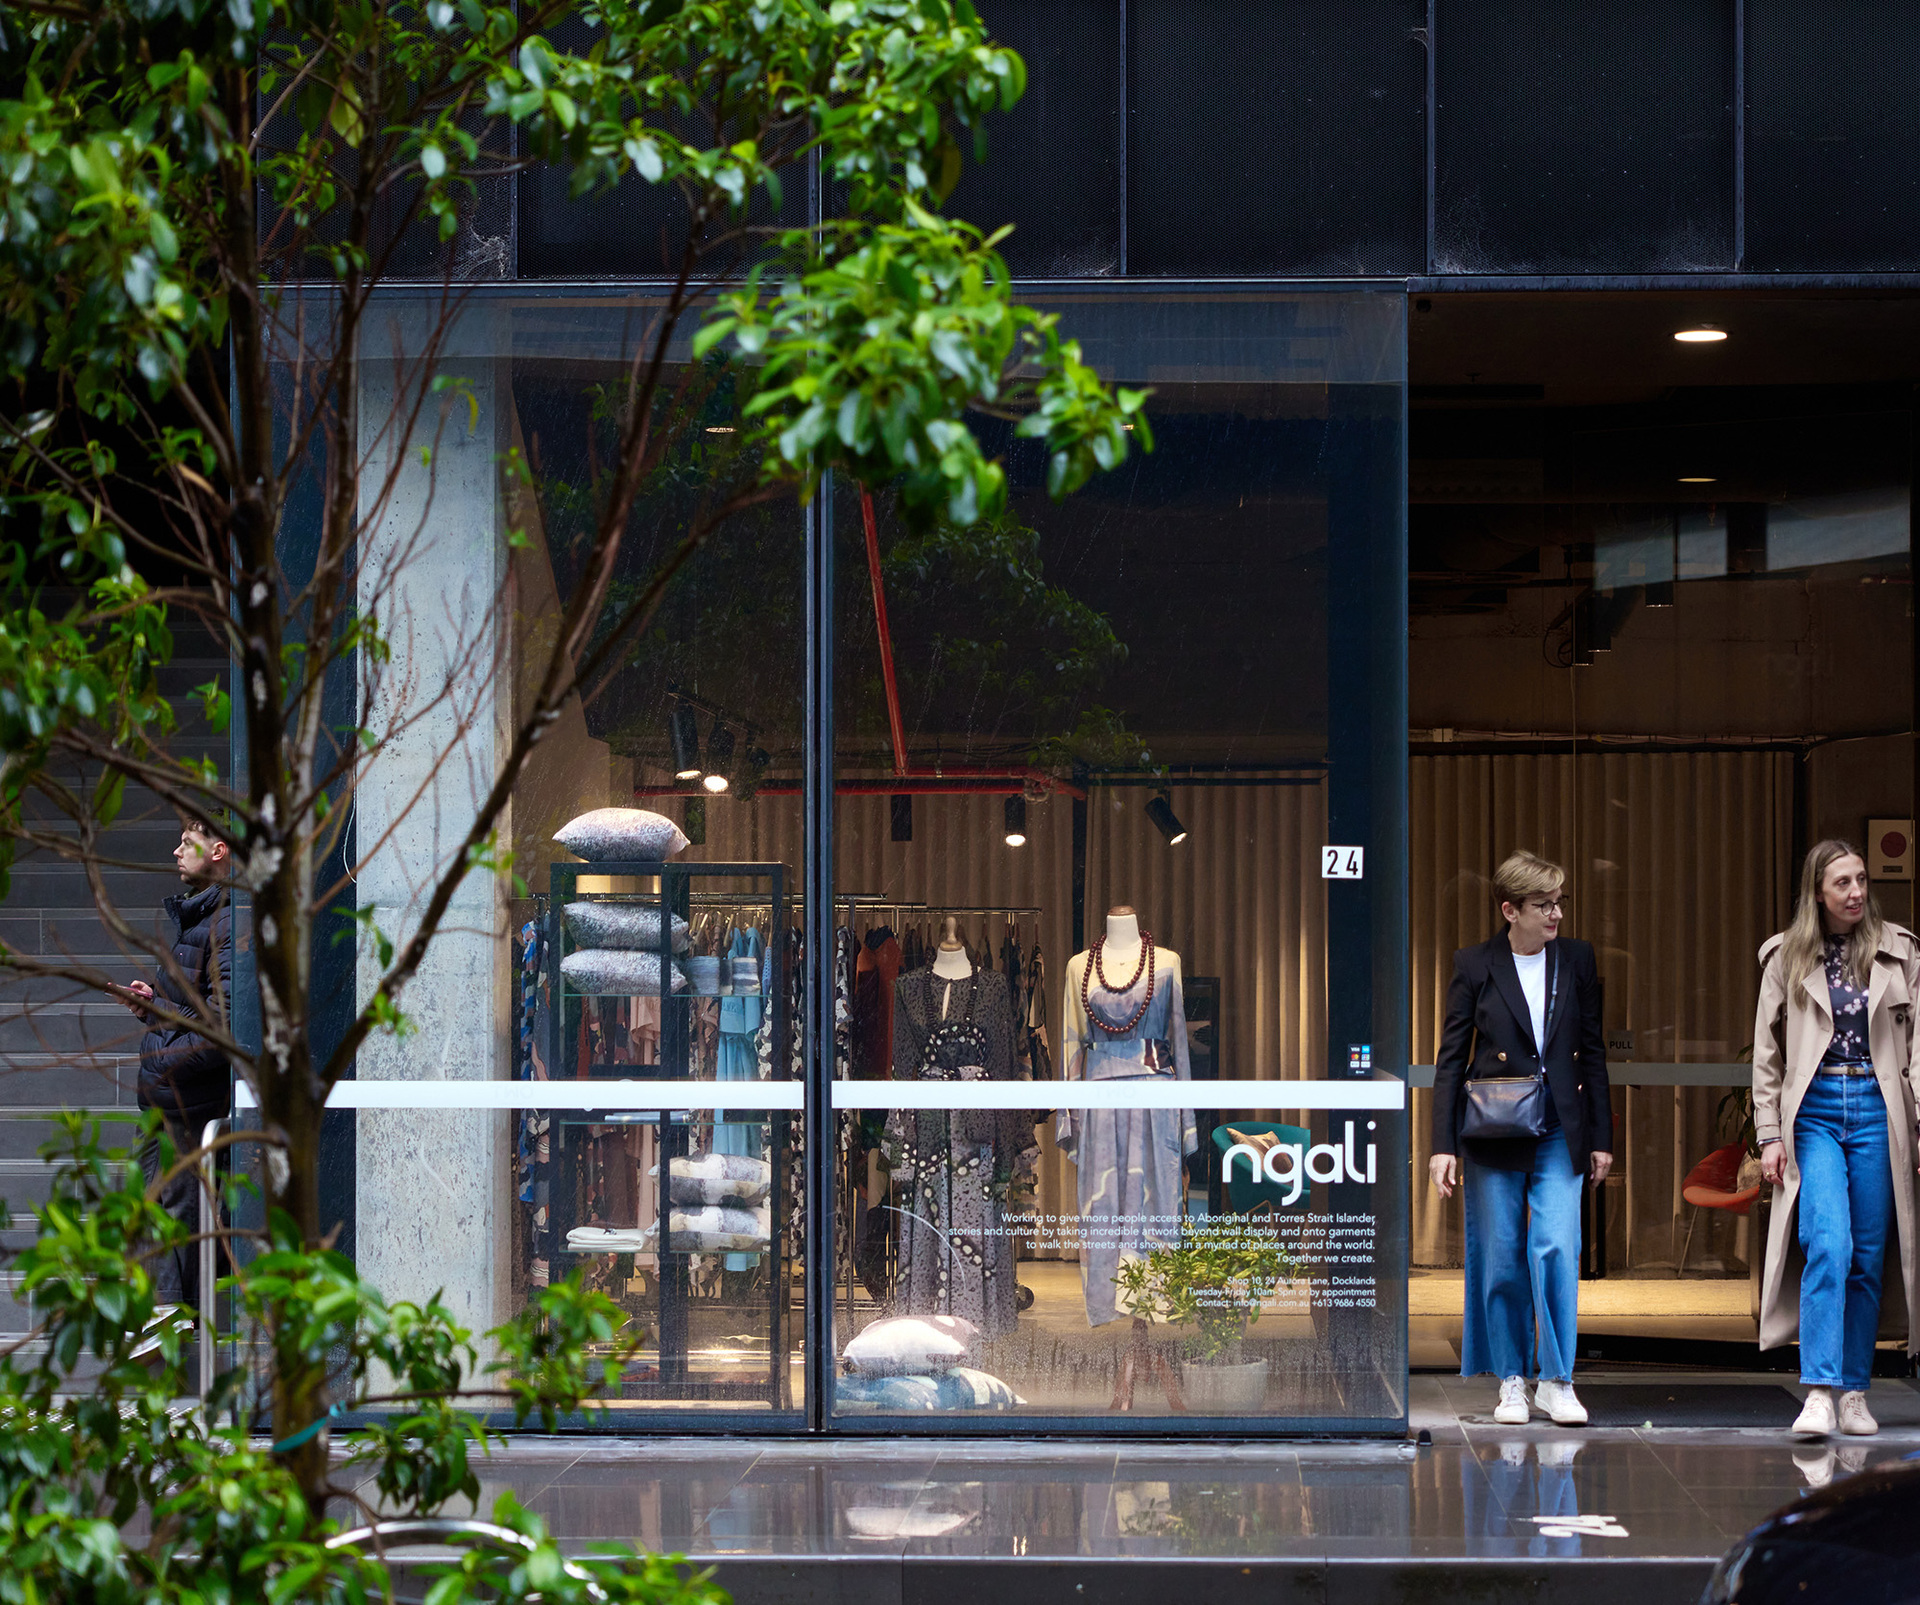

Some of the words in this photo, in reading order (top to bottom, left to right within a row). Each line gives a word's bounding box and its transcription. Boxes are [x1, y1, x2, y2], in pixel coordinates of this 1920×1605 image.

[1327, 849, 1359, 876] 24
[1609, 1041, 1633, 1050] PULL
[1222, 1120, 1377, 1207] ngali
[1001, 1213, 1043, 1225] Working
[1046, 1214, 1056, 1223] to
[1059, 1213, 1080, 1225] give
[1083, 1215, 1109, 1223] more
[1111, 1213, 1147, 1225] people
[1149, 1215, 1181, 1223] access
[1184, 1214, 1195, 1223] to
[1197, 1213, 1249, 1225] Aboriginal
[1252, 1213, 1271, 1223] and
[1273, 1213, 1305, 1223] Torres
[1307, 1213, 1333, 1223] Strait
[1336, 1213, 1376, 1225] Islander,
[948, 1226, 981, 1236] stories
[984, 1226, 1003, 1236] and
[1005, 1226, 1039, 1236] culture
[1042, 1226, 1055, 1238] by
[1057, 1226, 1087, 1238] taking
[1090, 1226, 1139, 1236] incredible
[1142, 1226, 1179, 1236] artwork
[1181, 1226, 1219, 1238] beyond
[1221, 1226, 1241, 1236] wall
[1243, 1226, 1278, 1238] display
[1281, 1226, 1300, 1236] and
[1302, 1227, 1326, 1236] onto
[1328, 1226, 1376, 1238] garments
[1026, 1240, 1037, 1249] to
[1039, 1239, 1061, 1249] walk
[1063, 1239, 1080, 1249] the
[1082, 1239, 1116, 1249] streets
[1118, 1239, 1138, 1249] and
[1139, 1239, 1165, 1249] show
[1168, 1241, 1182, 1251] up
[1184, 1239, 1193, 1249] in
[1204, 1239, 1238, 1251] myriad
[1240, 1239, 1251, 1249] of
[1253, 1239, 1285, 1251] places
[1287, 1239, 1323, 1249] around
[1325, 1239, 1342, 1249] the
[1344, 1239, 1376, 1249] world.
[1276, 1253, 1321, 1265] Together
[1324, 1255, 1339, 1263] we
[1341, 1253, 1376, 1263] create.
[1227, 1275, 1250, 1287] Shop
[1251, 1275, 1263, 1287] 10,
[1265, 1275, 1276, 1285] 24
[1277, 1275, 1306, 1285] Aurora
[1308, 1275, 1330, 1287] Lane,
[1332, 1275, 1376, 1285] Docklands
[1188, 1286, 1251, 1298] Tuesday-Friday
[1298, 1288, 1308, 1296] or
[1310, 1286, 1321, 1298] by
[1322, 1286, 1376, 1298] appointment
[1196, 1297, 1231, 1307] Contact:
[1311, 1297, 1333, 1307] +613
[1334, 1297, 1355, 1307] 9686
[1356, 1297, 1377, 1307] 4550
